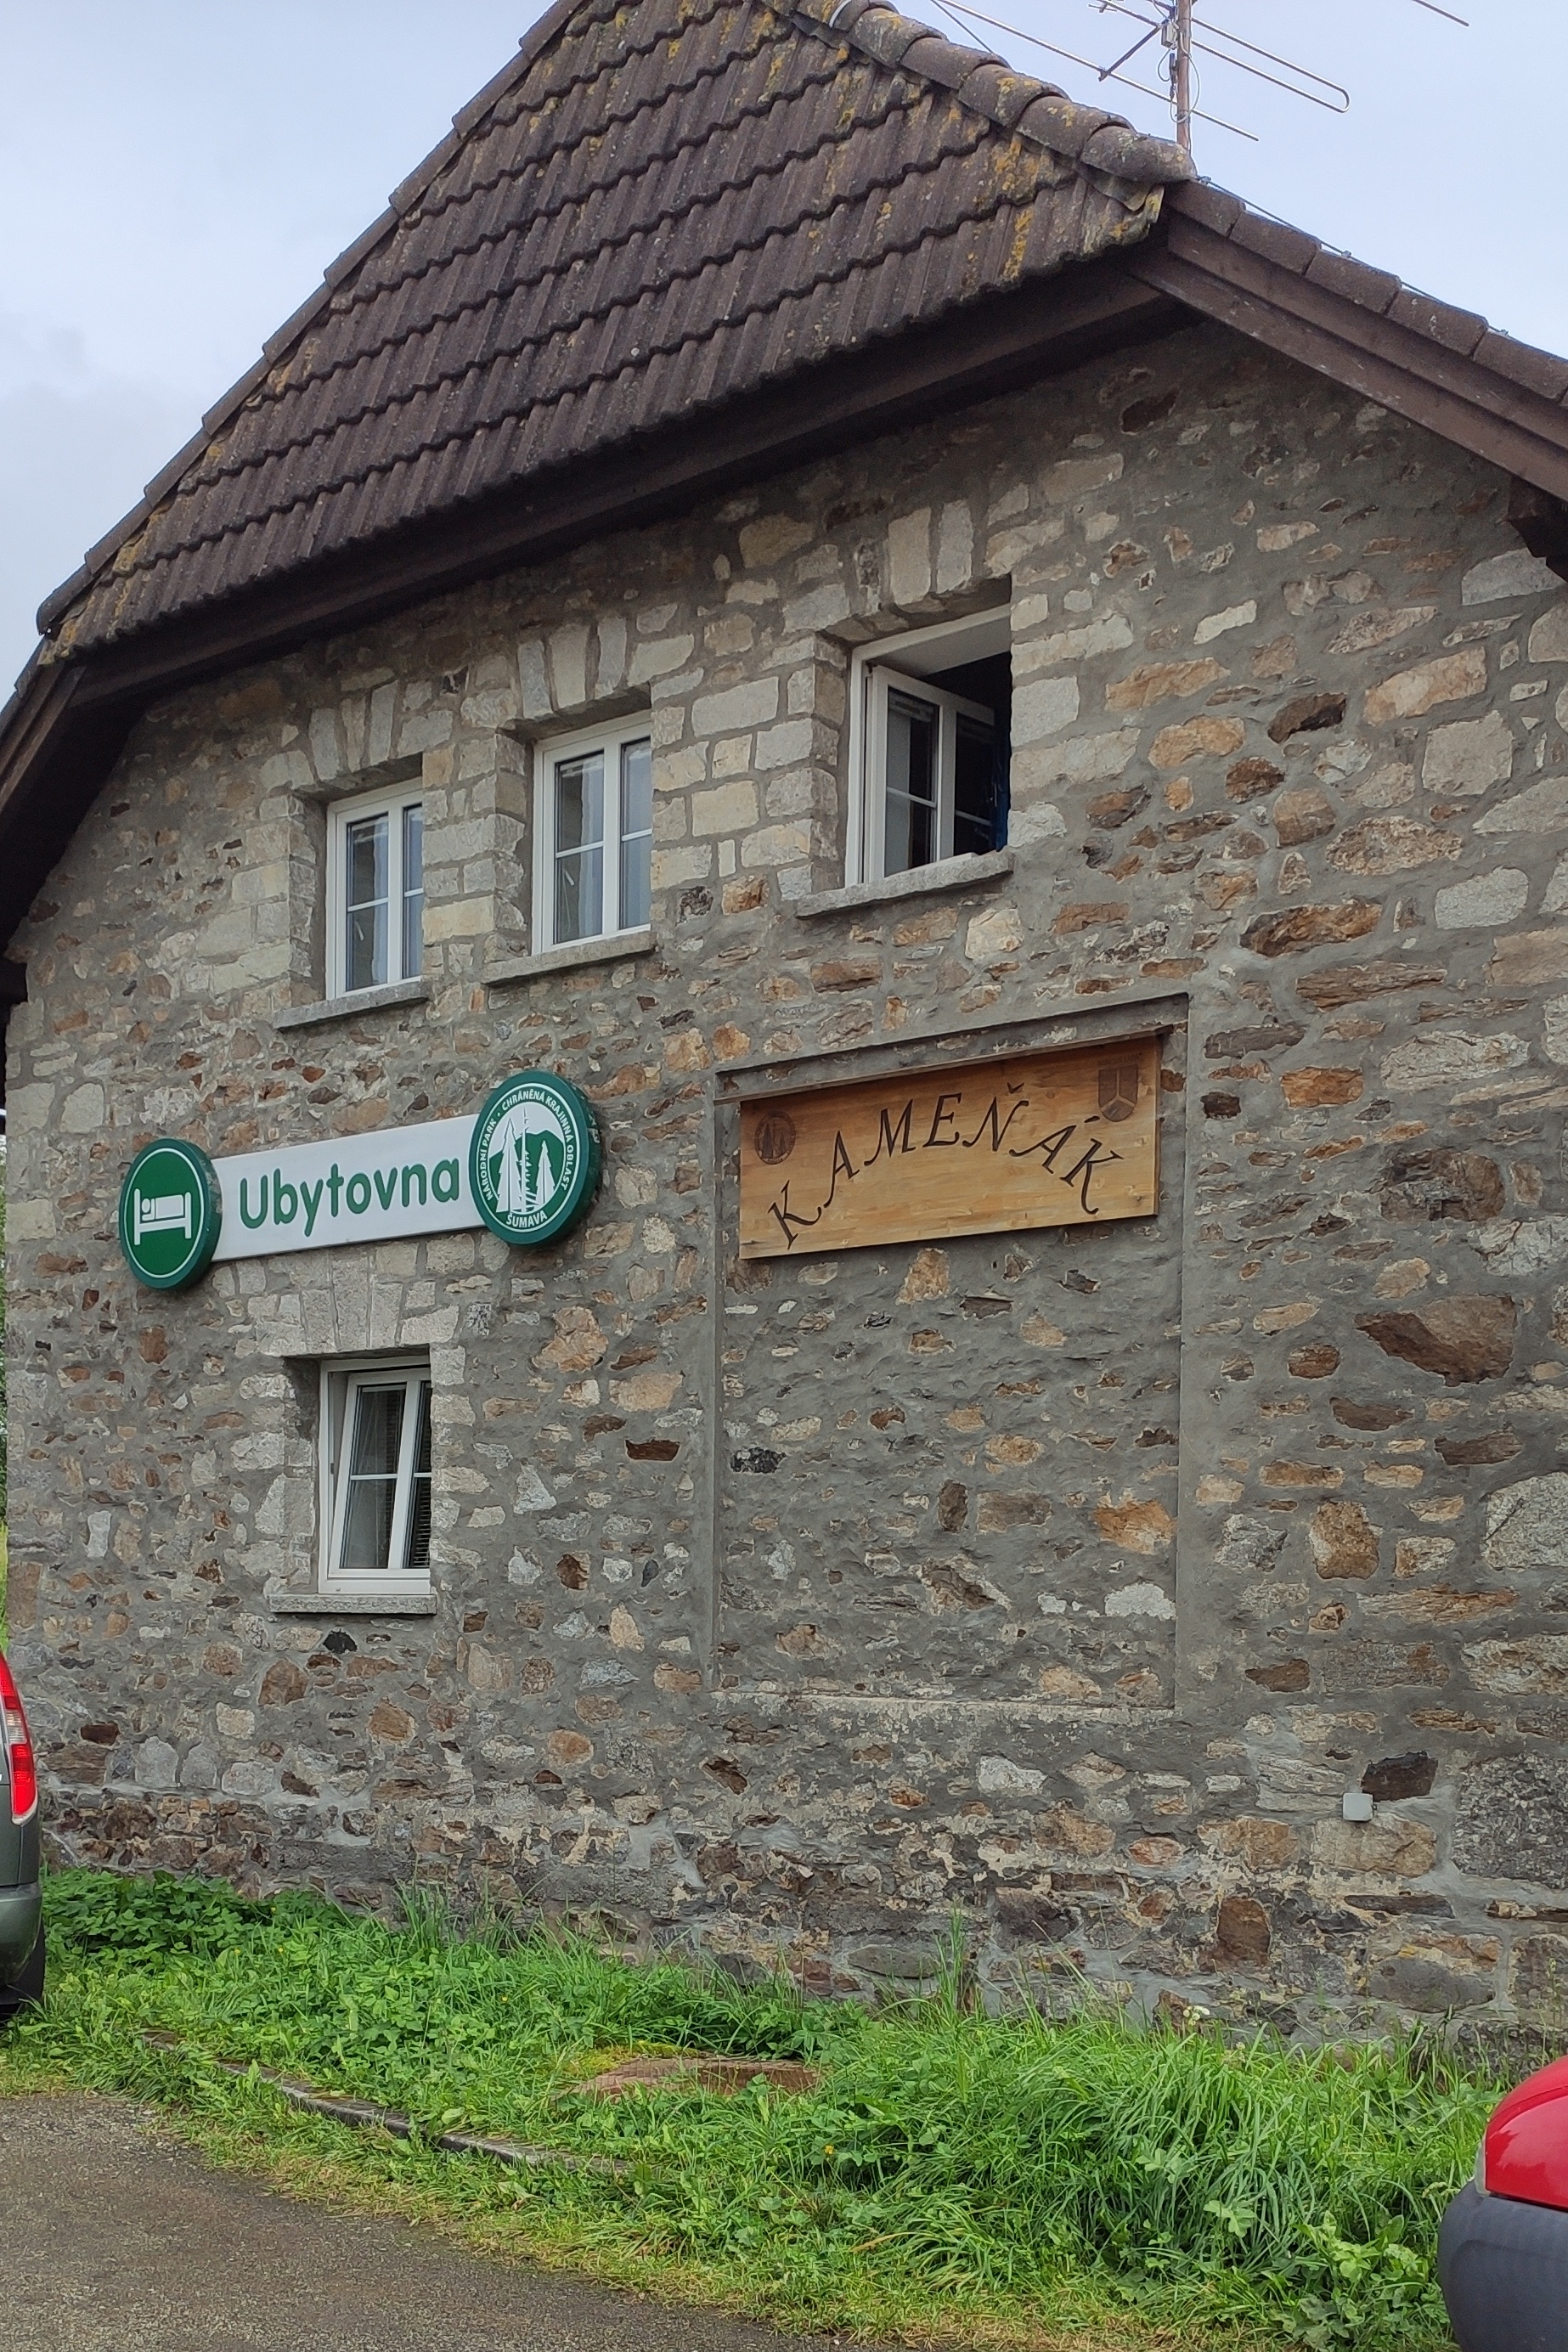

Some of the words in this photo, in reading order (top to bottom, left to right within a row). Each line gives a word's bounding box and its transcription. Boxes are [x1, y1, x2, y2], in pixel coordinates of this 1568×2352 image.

[482, 1117, 497, 1148] PARK
[502, 1089, 545, 1111] CHRÁNĚNÁ
[561, 1144, 573, 1190] OBLAST
[768, 1081, 1124, 1249] KAMEŇÁK
[240, 1158, 460, 1237] Ubytovna
[506, 1210, 548, 1228] ŠUMAVA
